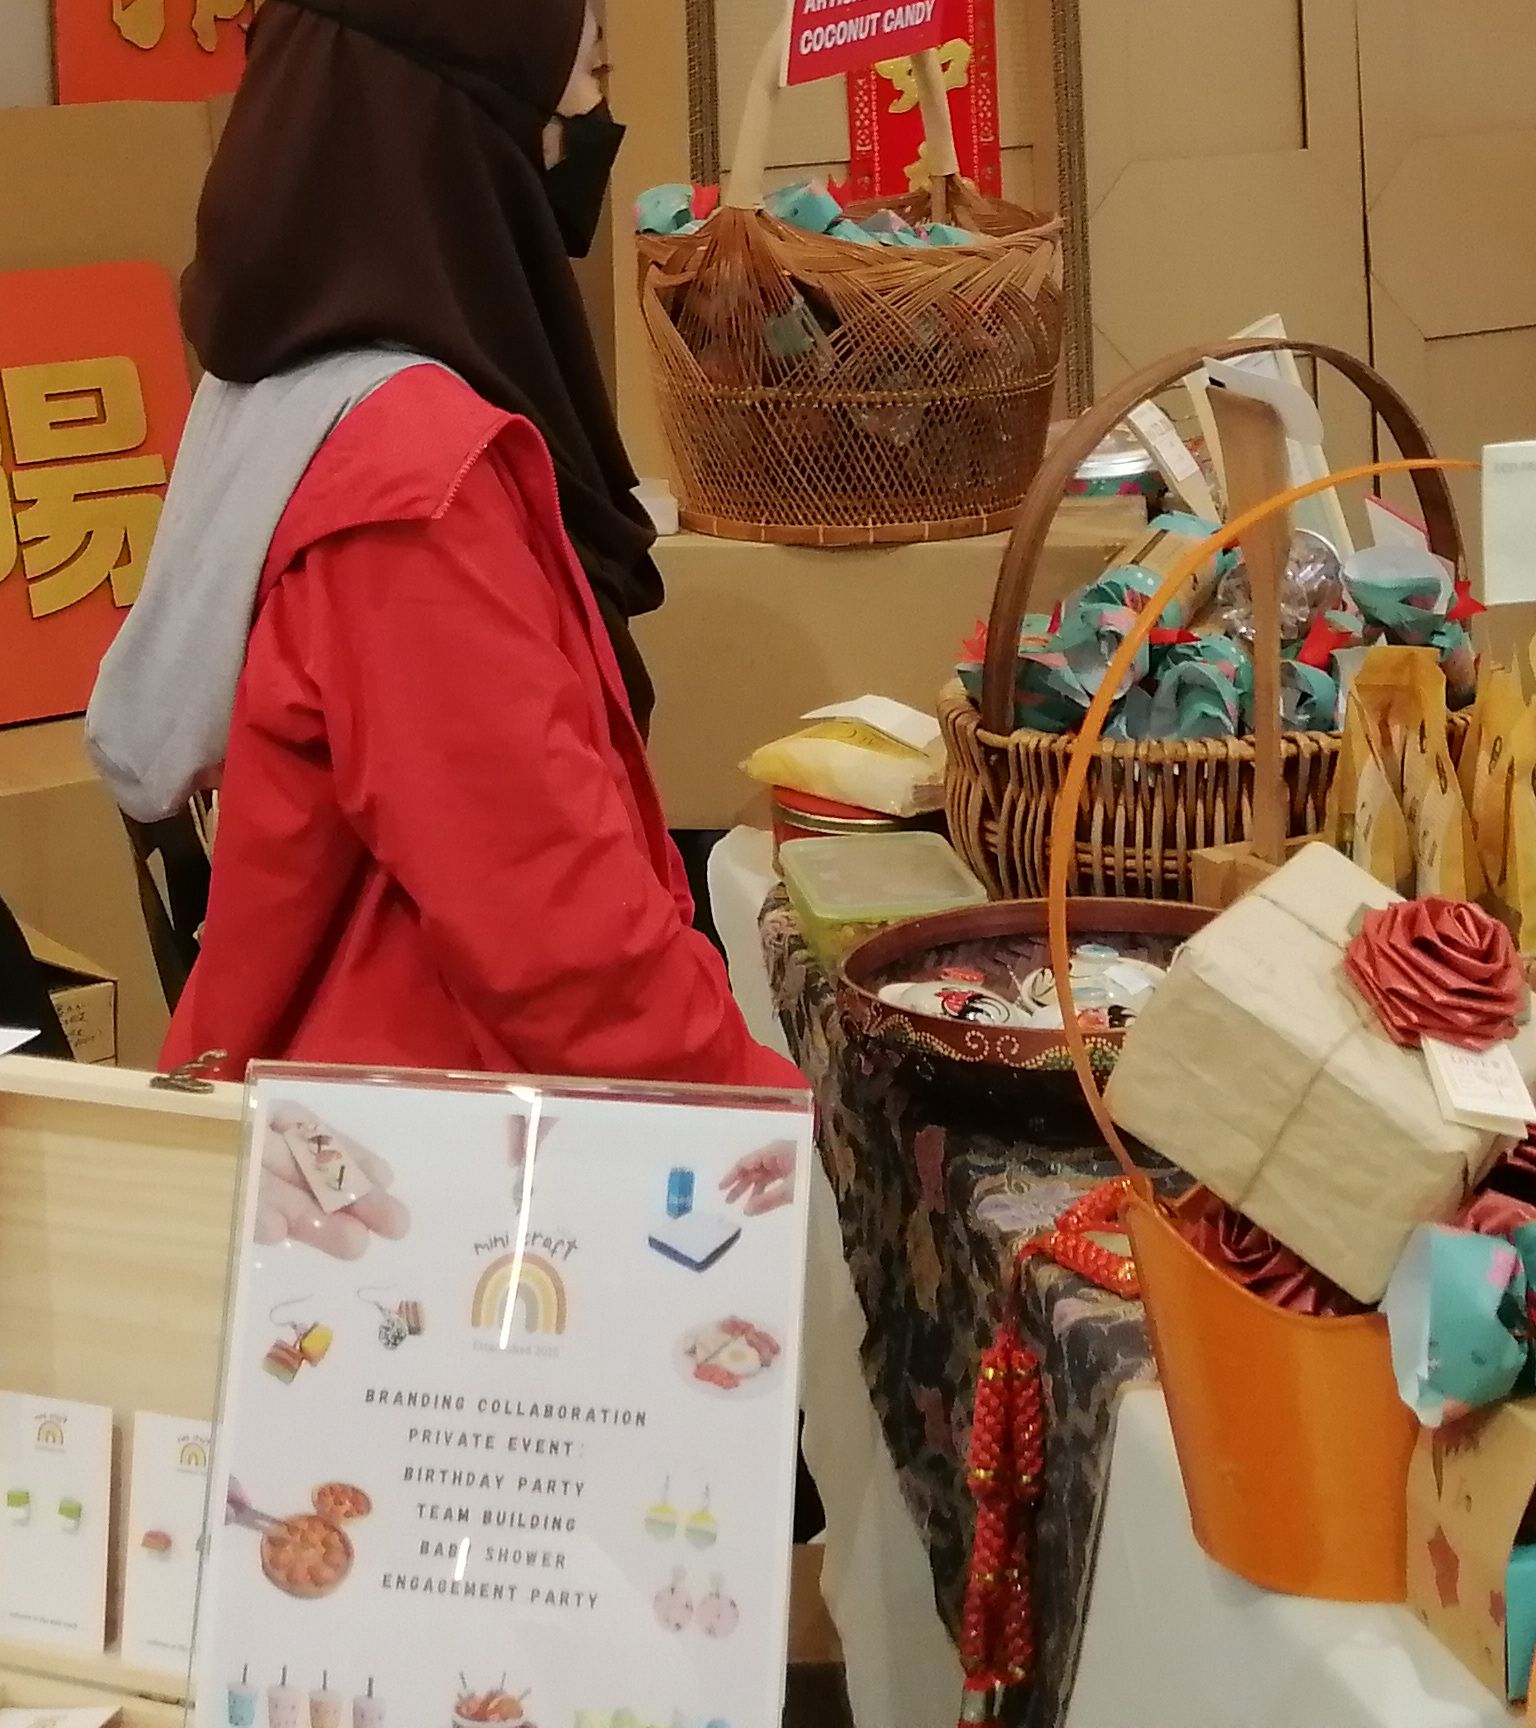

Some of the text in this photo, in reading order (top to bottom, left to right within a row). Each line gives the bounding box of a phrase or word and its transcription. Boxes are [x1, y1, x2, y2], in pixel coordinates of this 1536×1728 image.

[799, 12, 882, 55] COCONUT
[473, 1232, 510, 1255] mini
[364, 1387, 647, 1427] BRANDING COLLABORATION
[408, 1427, 574, 1457] PRIVATE EVENT
[403, 1465, 585, 1498] BIRTHDAY PARTY
[417, 1502, 576, 1533] TEAM BUILDING
[485, 1545, 566, 1570] SHOWER
[382, 1572, 600, 1609] ENGAGEMENT PARTY
